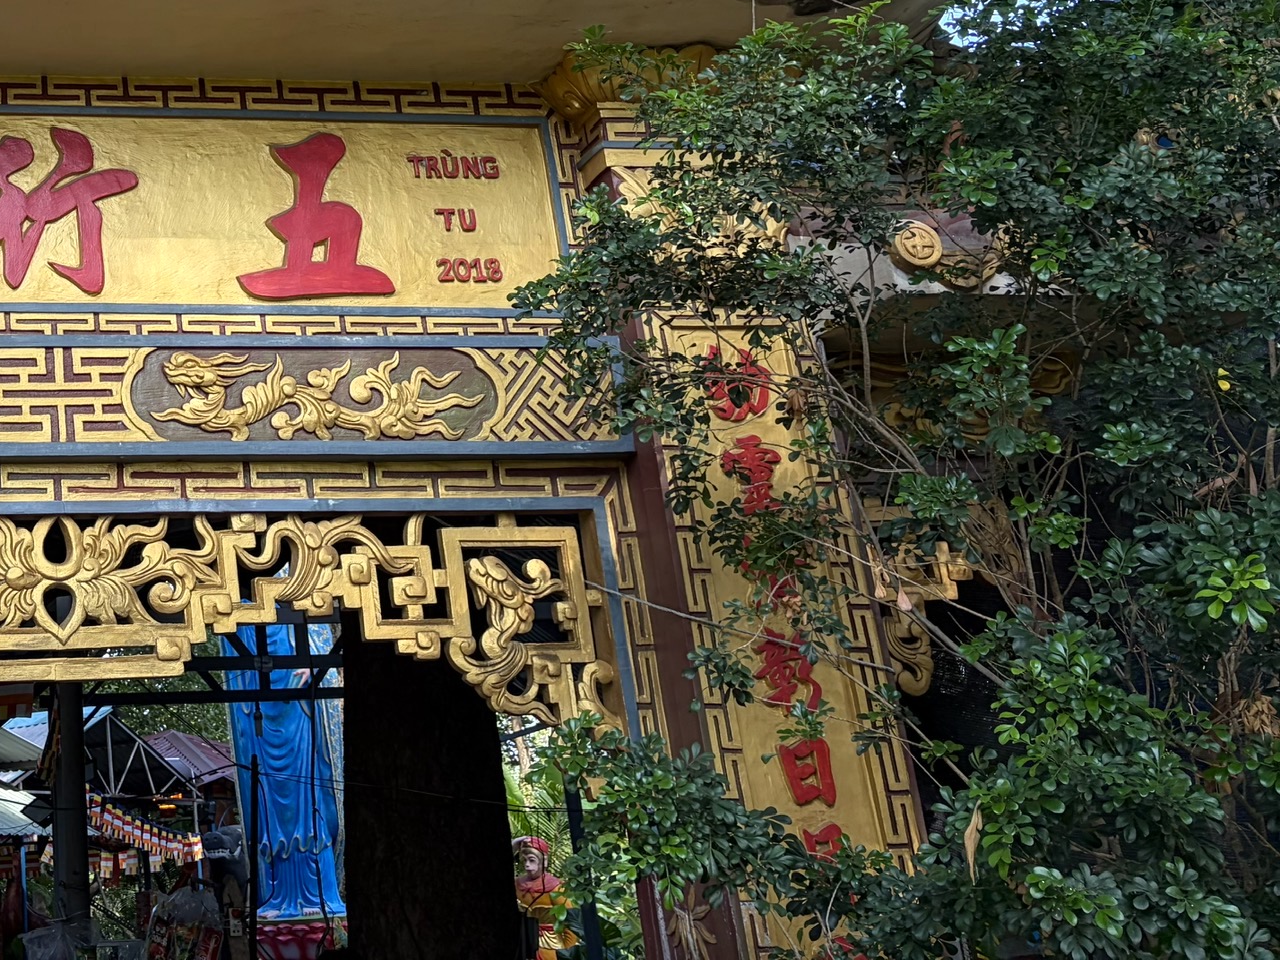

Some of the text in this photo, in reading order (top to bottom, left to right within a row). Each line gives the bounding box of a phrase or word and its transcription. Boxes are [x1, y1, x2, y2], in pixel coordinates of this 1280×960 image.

[406, 149, 500, 179] TRÙNG
[434, 208, 477, 232] TU
[436, 257, 503, 283] 2018
